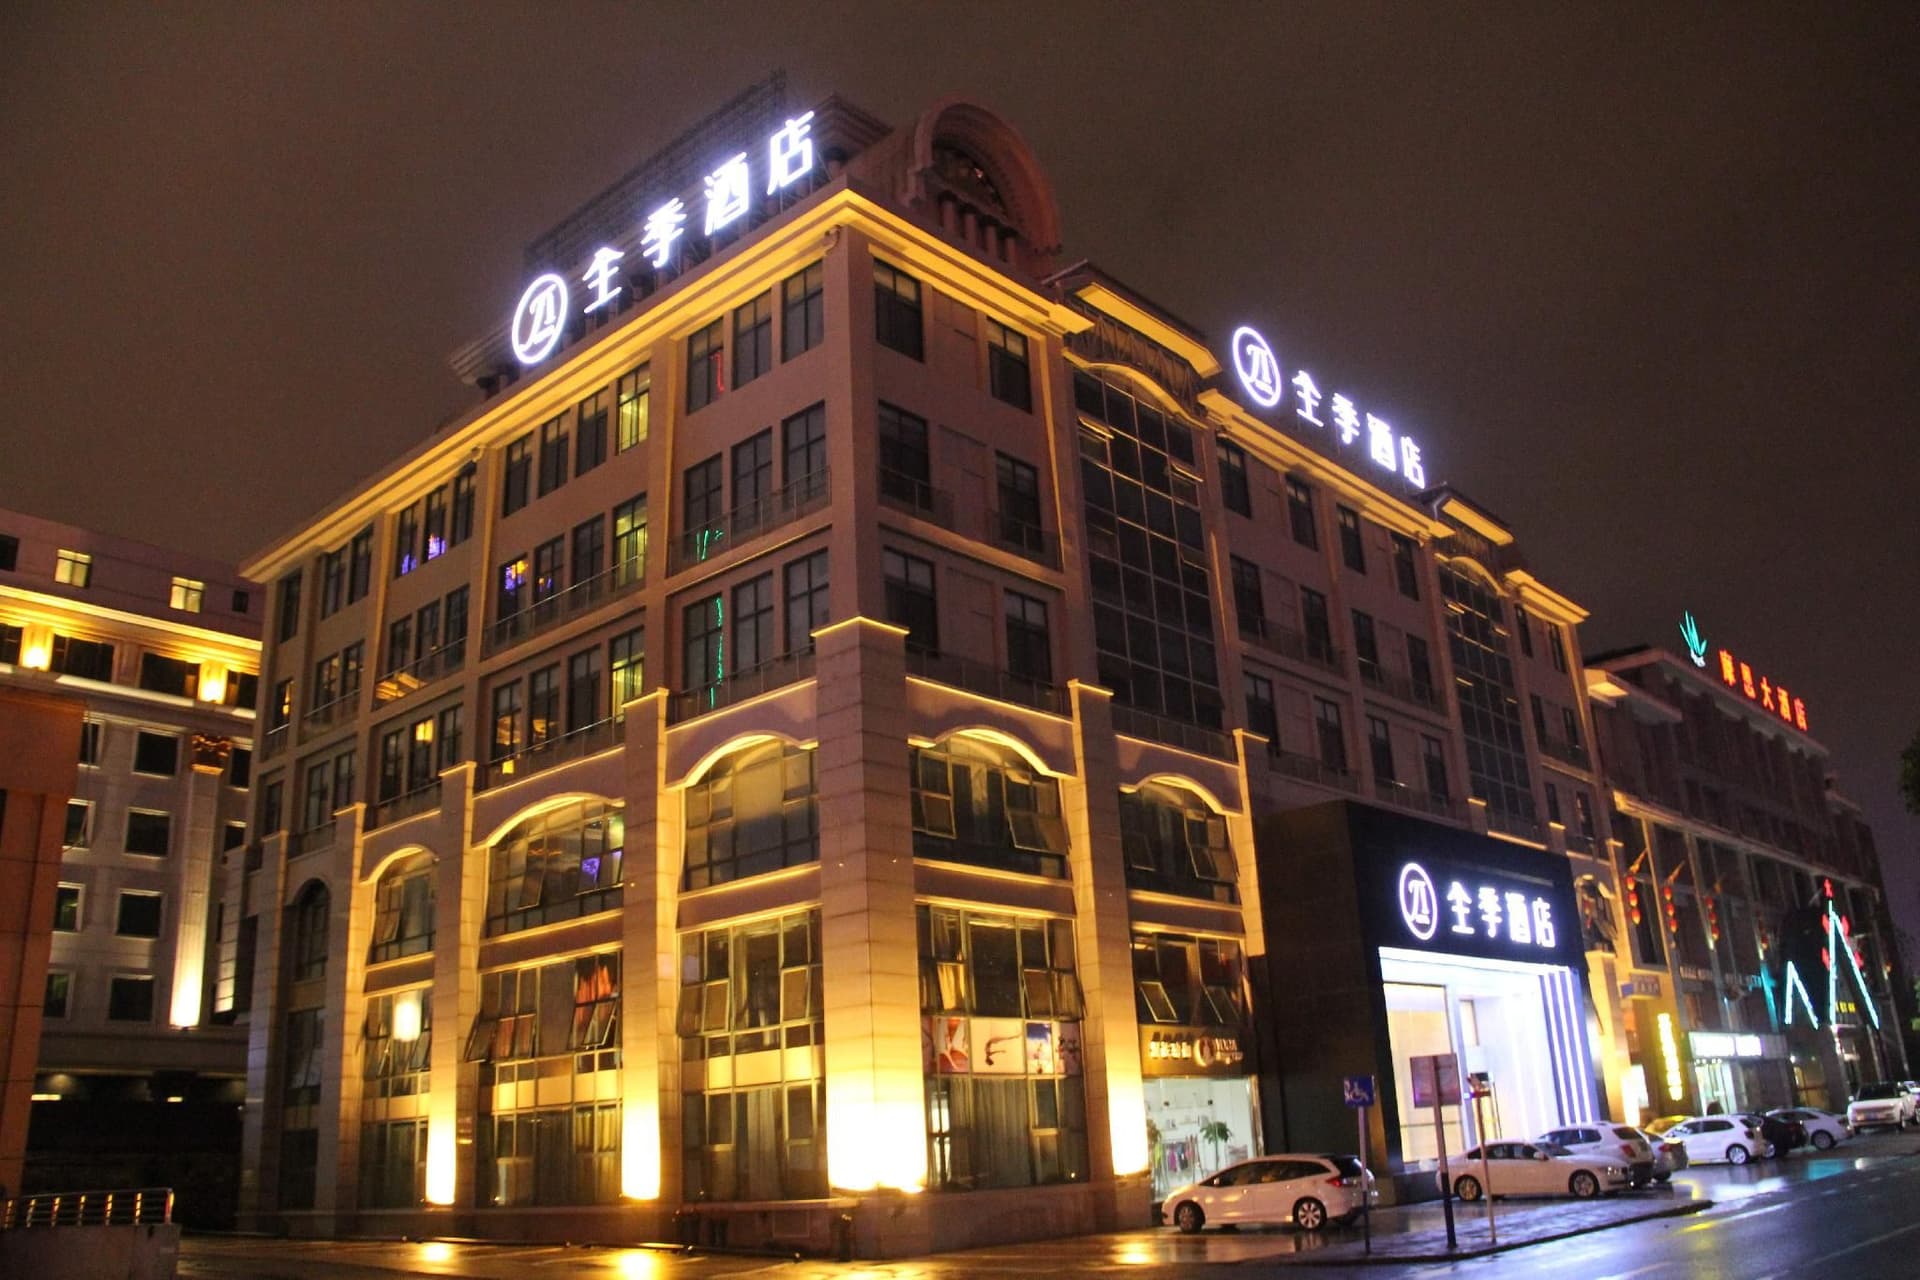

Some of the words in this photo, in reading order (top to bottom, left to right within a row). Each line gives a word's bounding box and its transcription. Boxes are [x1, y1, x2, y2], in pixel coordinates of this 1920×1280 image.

[582, 110, 815, 314] 全季酒店
[1291, 370, 1426, 490] 全季酒店
[1446, 881, 1557, 949] 全季酒店
